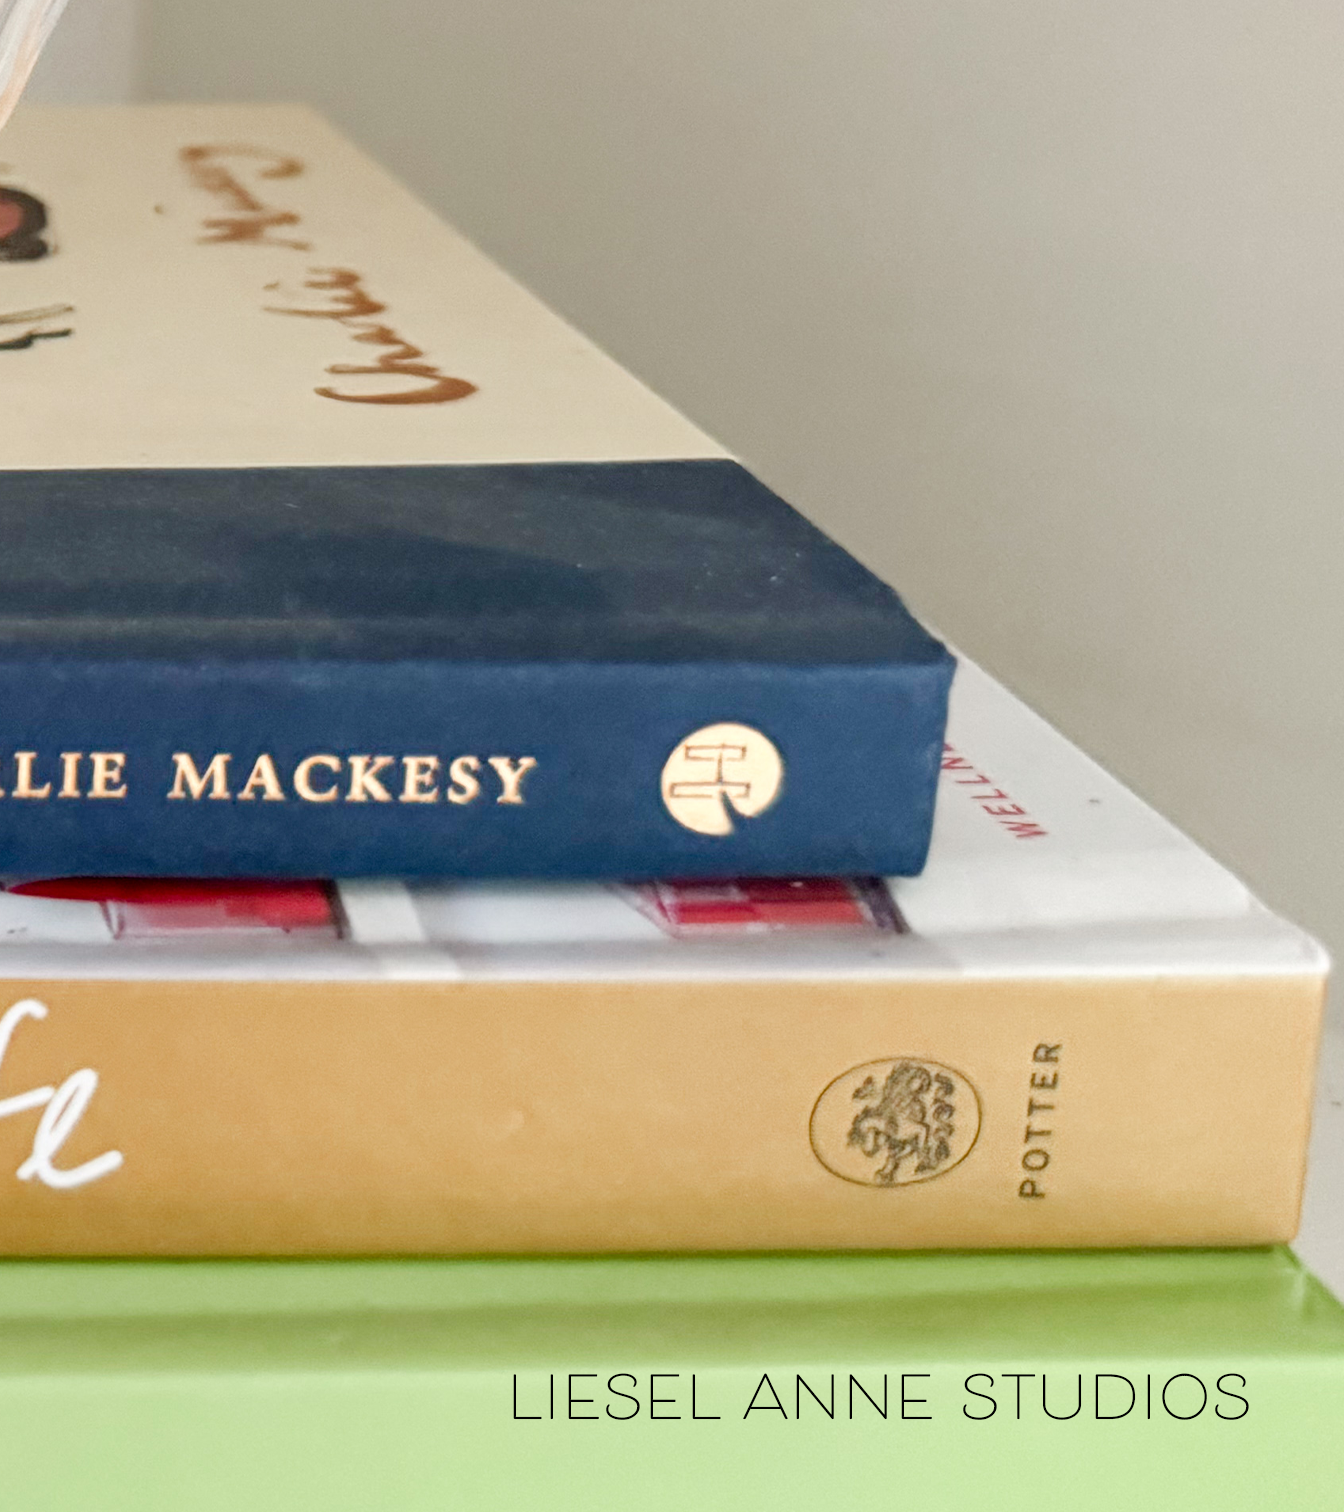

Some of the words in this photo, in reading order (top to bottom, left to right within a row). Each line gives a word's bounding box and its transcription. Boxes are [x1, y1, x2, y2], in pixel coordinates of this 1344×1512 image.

[168, 753, 537, 806] MACKESY
[941, 742, 1049, 839] WELLN
[1018, 1044, 1062, 1202] POTTER
